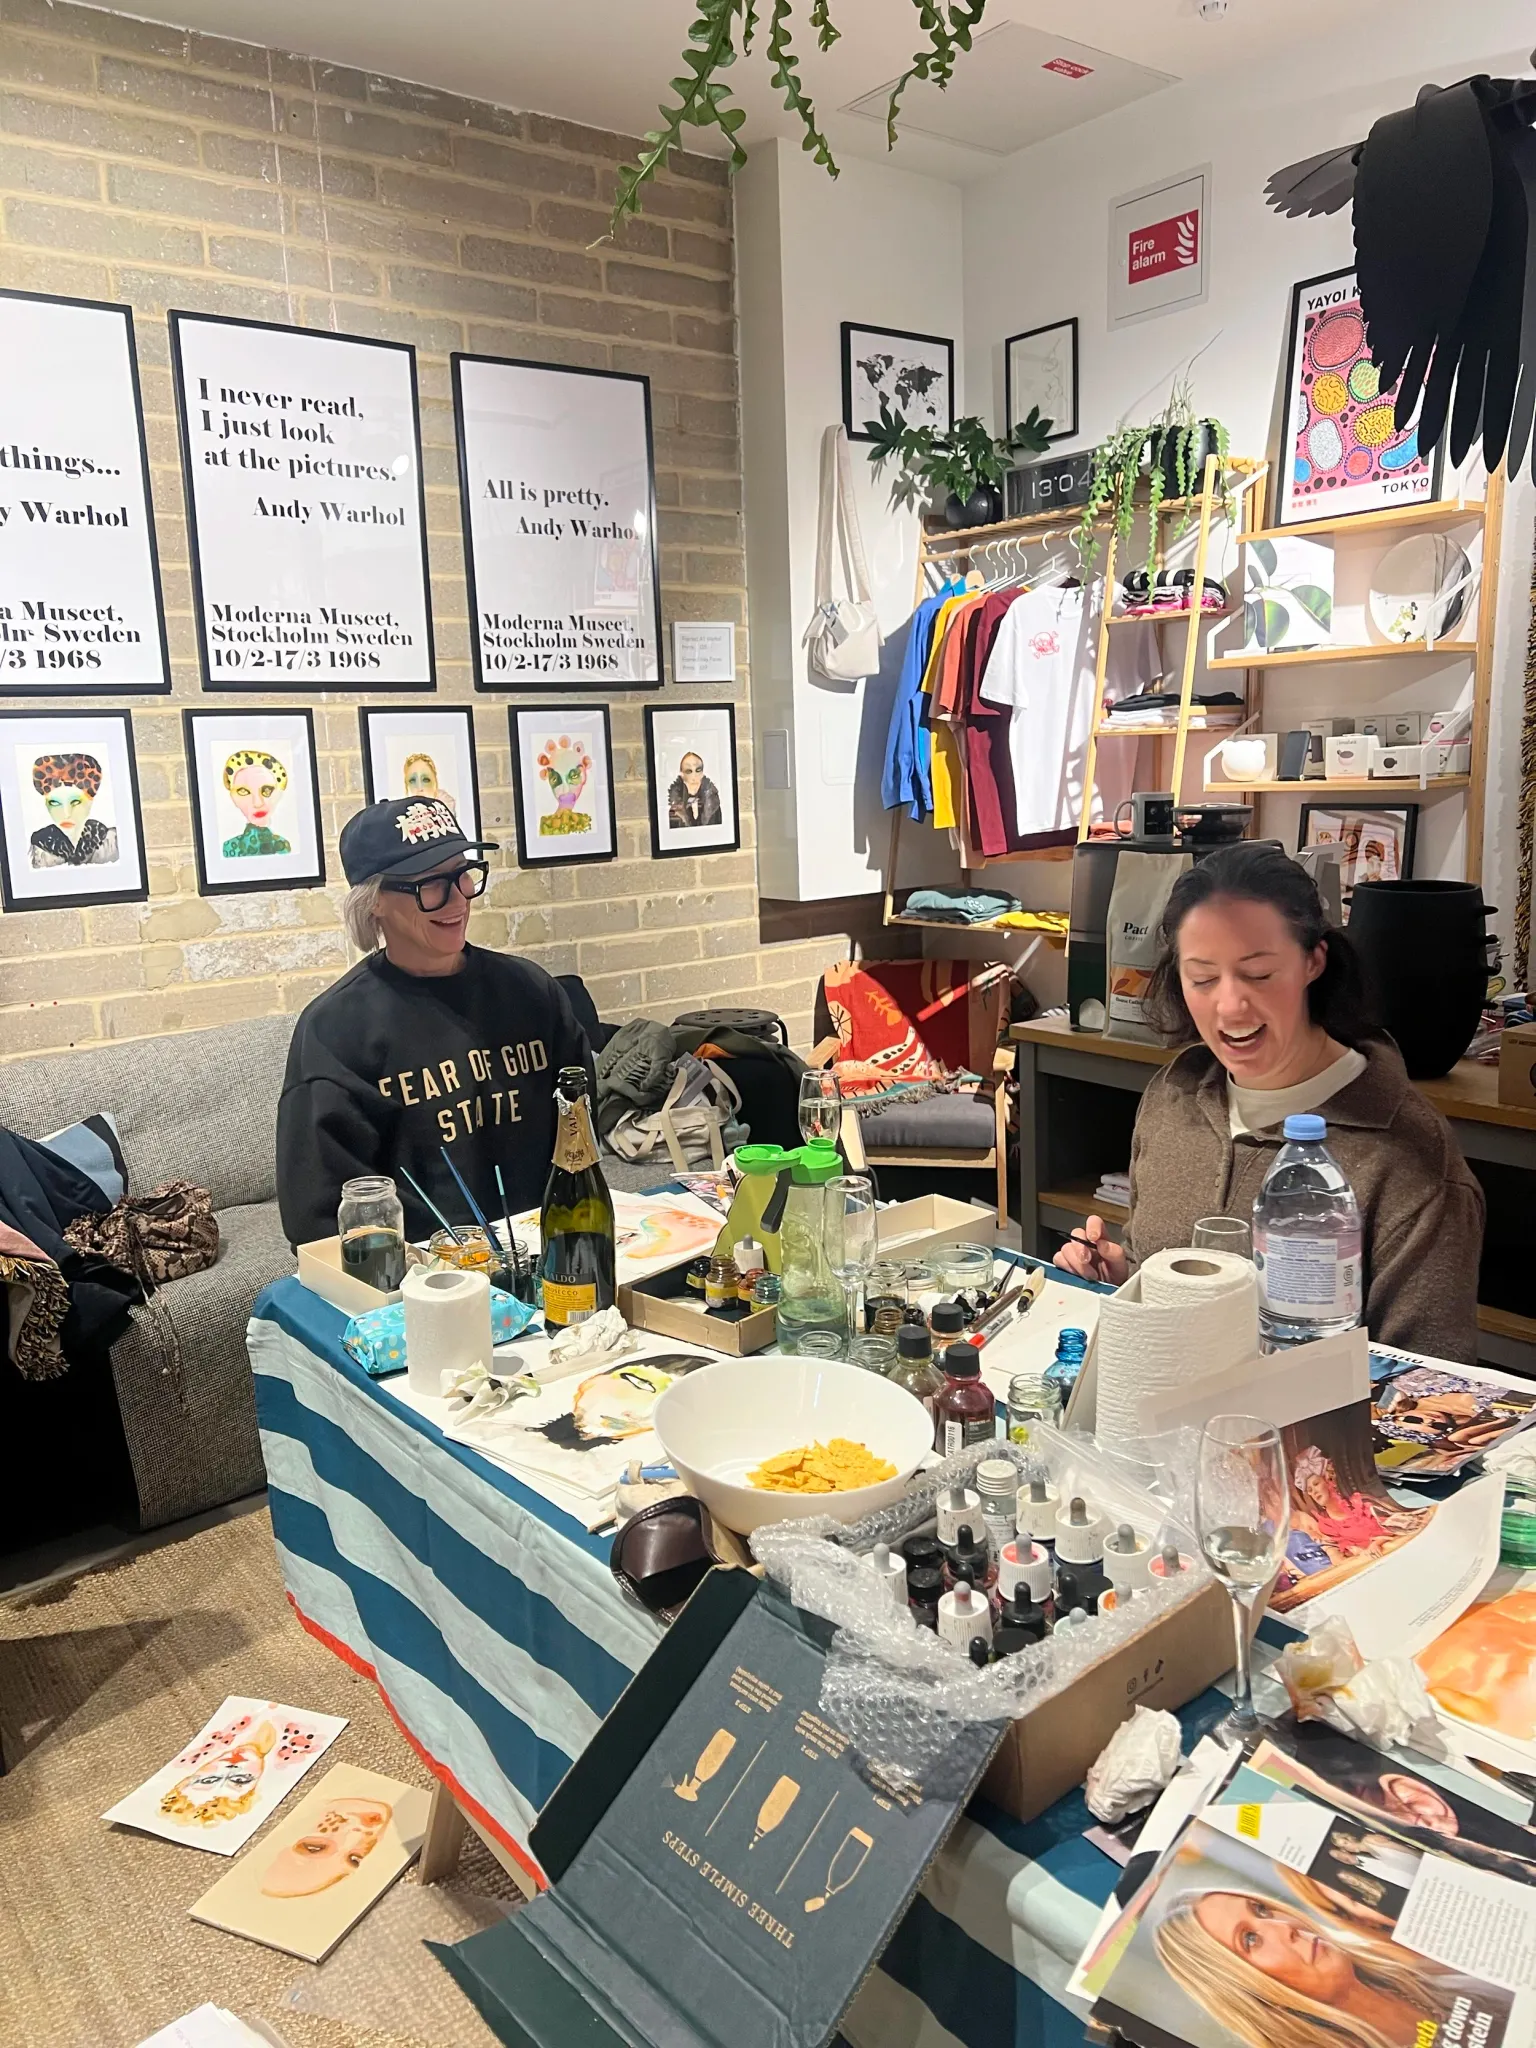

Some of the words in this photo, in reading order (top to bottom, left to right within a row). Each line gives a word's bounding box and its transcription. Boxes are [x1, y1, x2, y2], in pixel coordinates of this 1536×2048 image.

[1132, 239, 1155, 256] Fire
[1132, 251, 1166, 271] alarm
[1307, 289, 1347, 311] YAYOI
[197, 377, 210, 401] I
[220, 387, 293, 410] never
[300, 397, 365, 421] read,
[199, 409, 213, 432] I
[218, 412, 273, 440] just
[280, 418, 335, 444] look
[0, 445, 120, 480] things...
[204, 447, 231, 467] at
[238, 448, 281, 472] the
[288, 453, 397, 481] pictures.
[483, 479, 513, 500] All
[520, 482, 537, 501] is
[543, 488, 609, 511] pretty.
[1381, 477, 1429, 495] TOKYO
[19, 500, 130, 527] Warhol
[253, 496, 313, 524] Andy
[320, 501, 406, 526] Warhol
[516, 516, 566, 541] Andy
[569, 518, 639, 541] Warho
[19, 601, 124, 624] Museet,
[210, 604, 311, 625] Moderna
[318, 607, 399, 629] Museet,
[483, 613, 564, 631] Moderna
[568, 615, 634, 634] Museet,
[44, 622, 141, 643] Sweden
[211, 624, 330, 645] Stockholm
[335, 628, 413, 646] Sweden
[483, 631, 578, 649] Stockholm
[582, 633, 645, 649] Sweden
[34, 649, 102, 669] 1968
[213, 649, 322, 670] 10/2-17/3
[328, 651, 381, 669] 1968
[485, 653, 572, 672] 10/2-17/3
[576, 654, 619, 670] 1968
[1123, 922, 1149, 935] Pact
[378, 1059, 461, 1106] FEAR
[467, 1049, 493, 1082] OF
[501, 1039, 549, 1077] GOD
[437, 1089, 523, 1143] STATE
[804, 1747, 819, 1761] STEP
[661, 1831, 701, 1868] STEPS
[699, 1860, 749, 1908] SIMPLE
[748, 1901, 796, 1949] THREE
[1442, 1996, 1472, 2041] down
